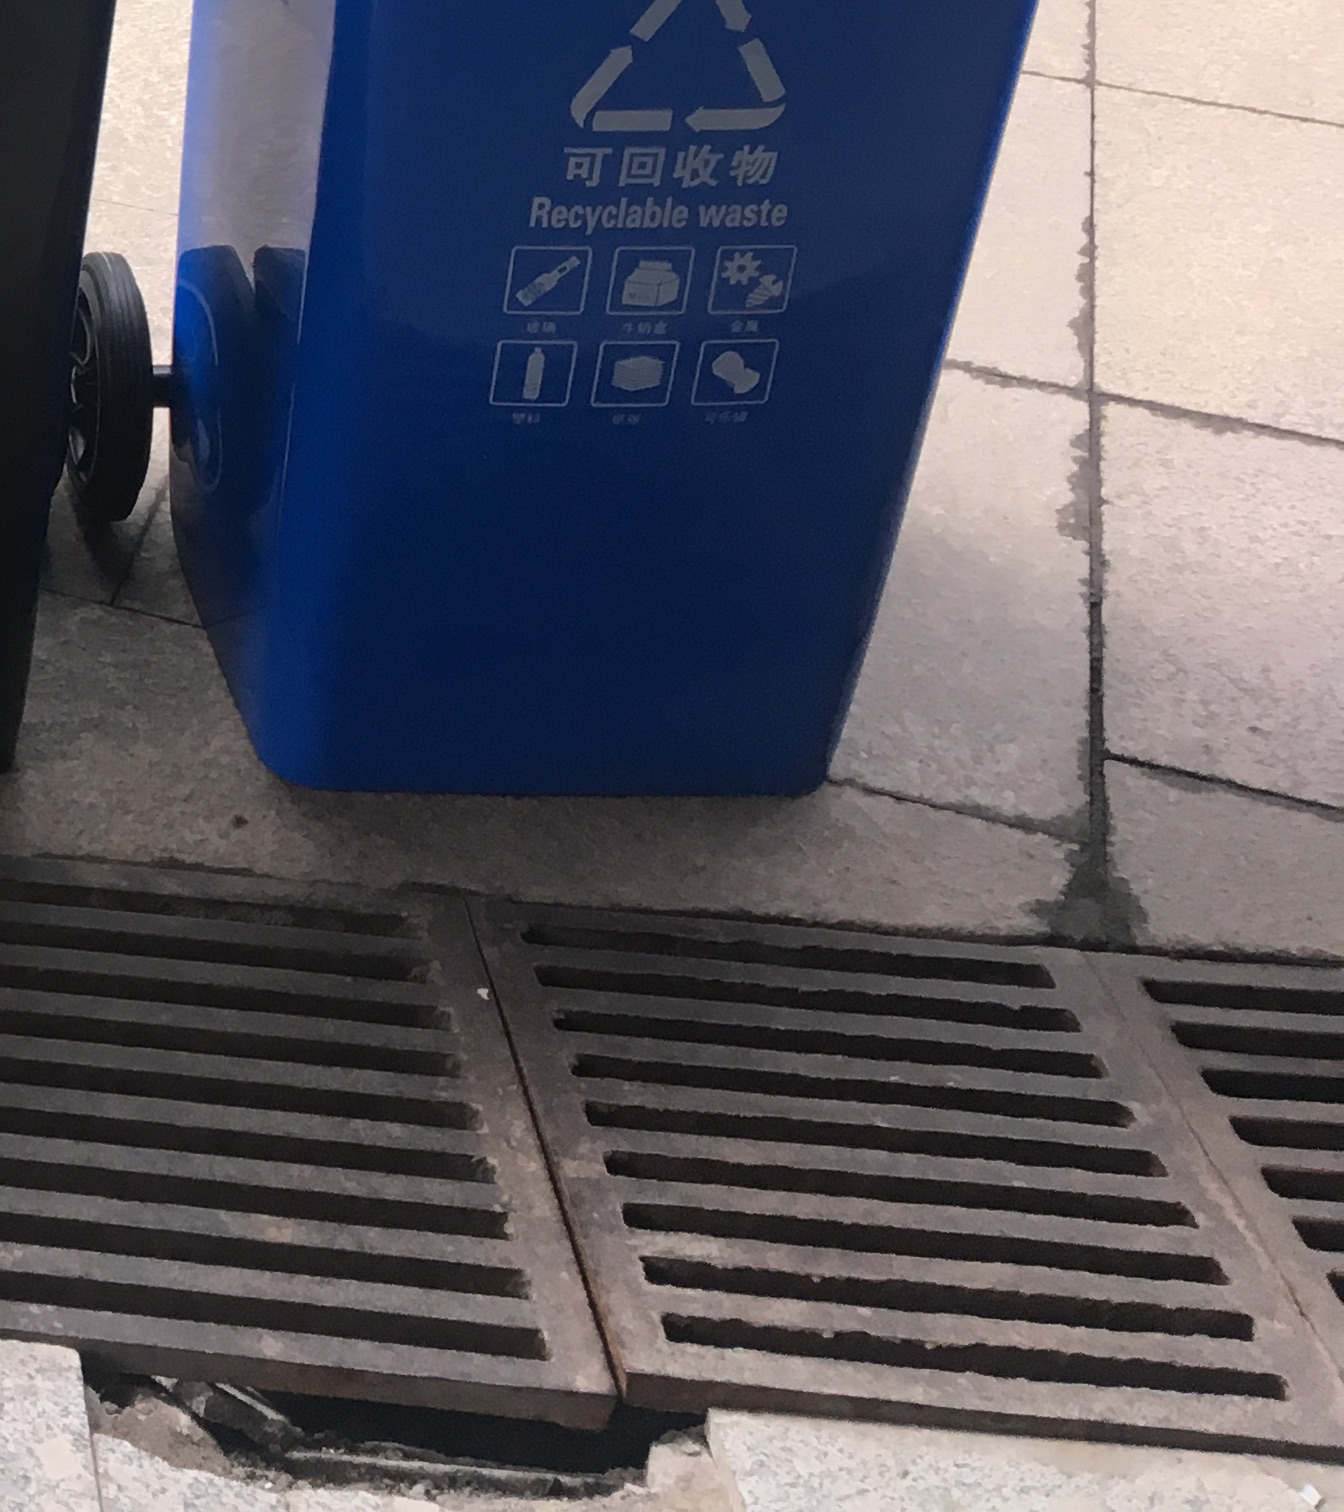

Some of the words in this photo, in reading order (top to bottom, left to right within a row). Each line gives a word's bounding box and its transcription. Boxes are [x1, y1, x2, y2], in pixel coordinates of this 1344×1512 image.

[564, 144, 778, 188] 可回收物
[529, 195, 689, 235] Recyclable
[699, 199, 788, 227] waste
